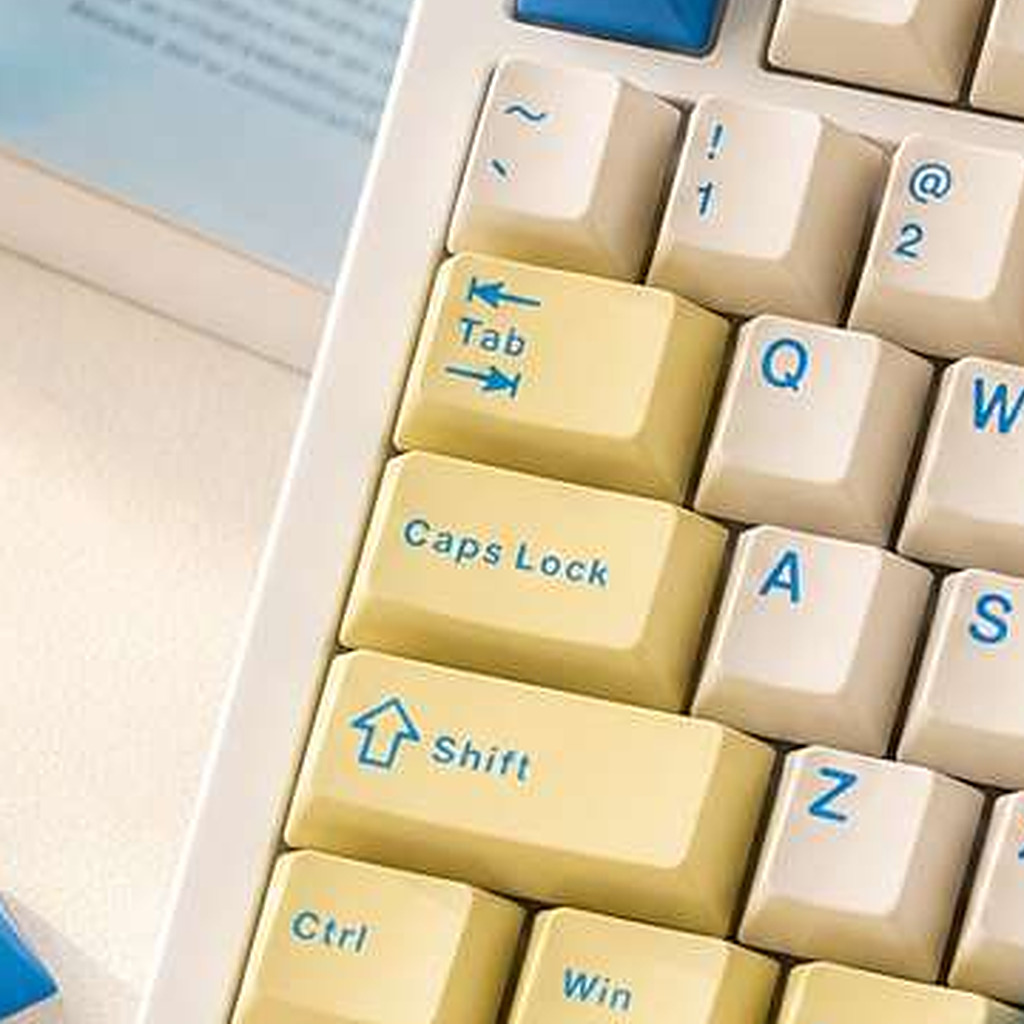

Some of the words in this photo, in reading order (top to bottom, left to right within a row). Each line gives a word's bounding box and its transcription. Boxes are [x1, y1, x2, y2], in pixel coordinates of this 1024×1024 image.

[707, 124, 723, 160] !
[698, 182, 713, 216] 1
[908, 163, 952, 204] @
[894, 223, 923, 259] 2
[460, 317, 526, 357] Tab
[761, 338, 809, 391] Q
[403, 518, 503, 566] Caps
[514, 543, 608, 587] Lock
[759, 550, 800, 603] A
[969, 594, 1013, 644] S
[431, 735, 529, 782] Shift
[808, 767, 857, 822] Z
[291, 910, 368, 953] Ctrl
[563, 968, 631, 1010] Win
